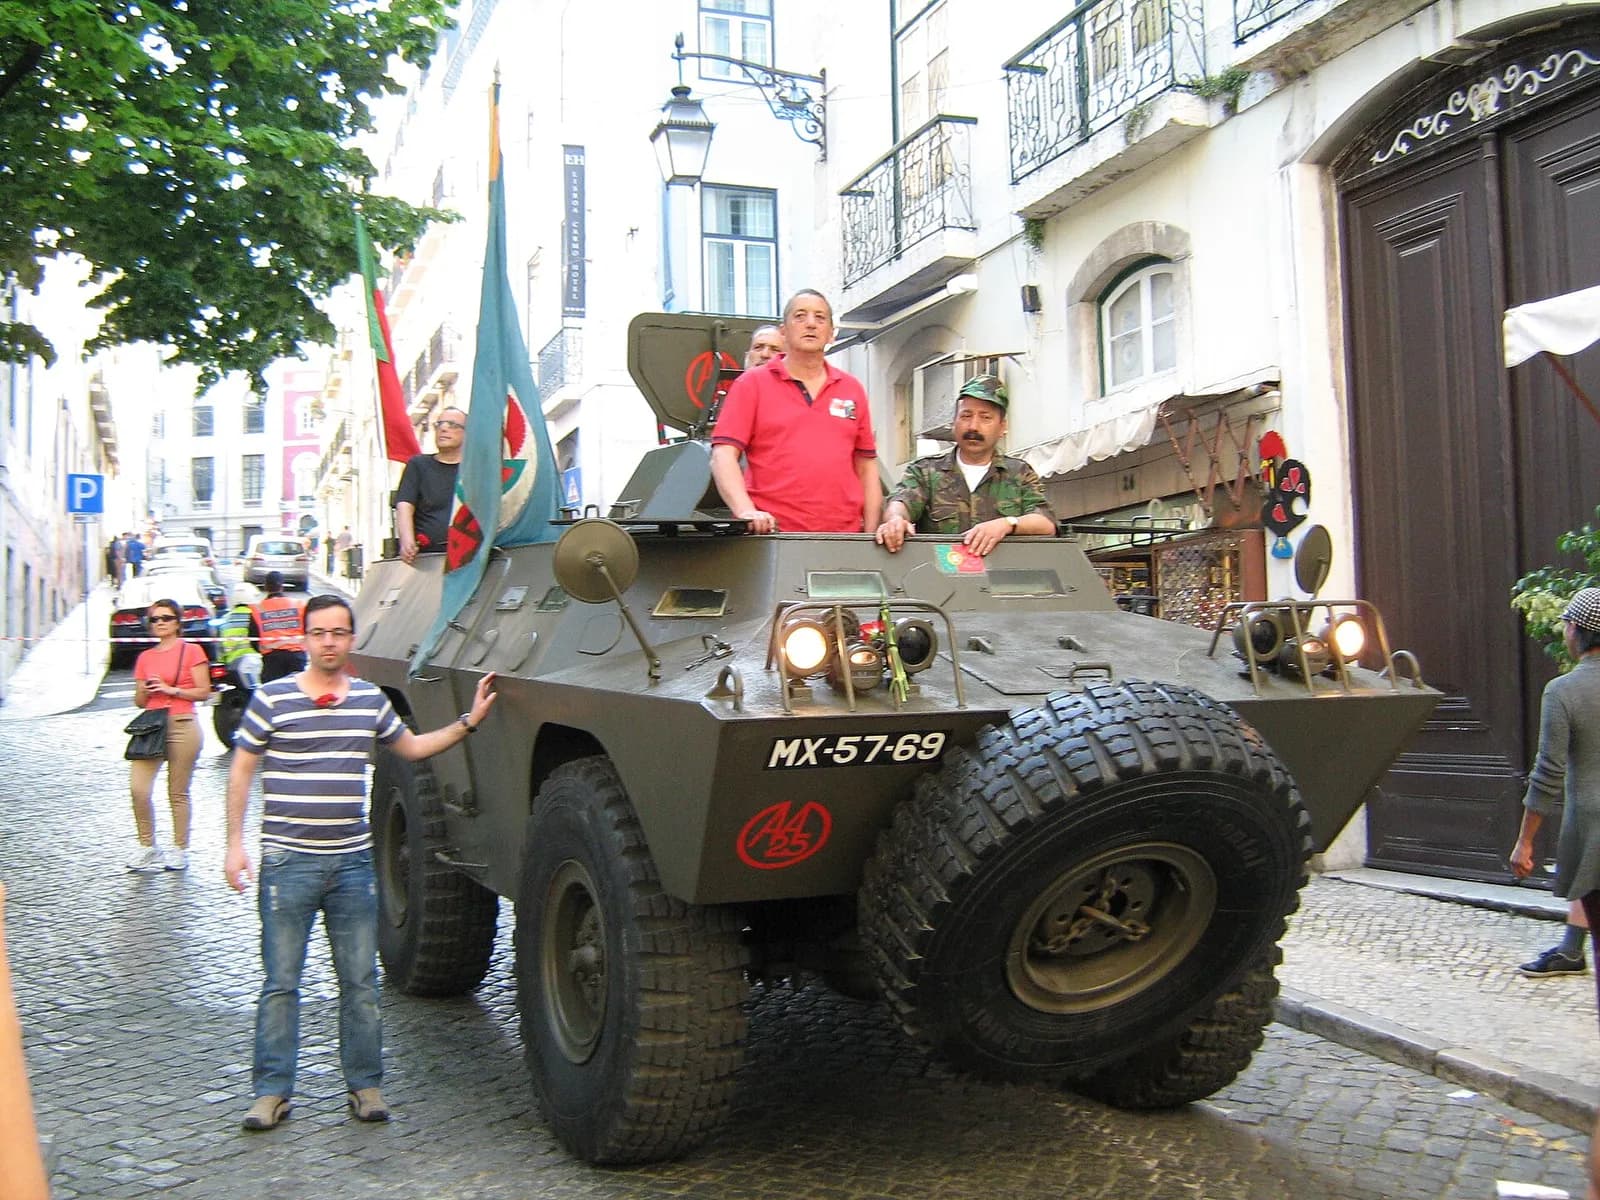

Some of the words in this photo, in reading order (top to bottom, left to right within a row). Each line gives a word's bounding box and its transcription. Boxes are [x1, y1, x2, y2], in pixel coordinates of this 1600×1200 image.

[571, 264, 579, 300] HOTEL
[74, 477, 98, 509] P
[767, 732, 946, 768] MX-57-69
